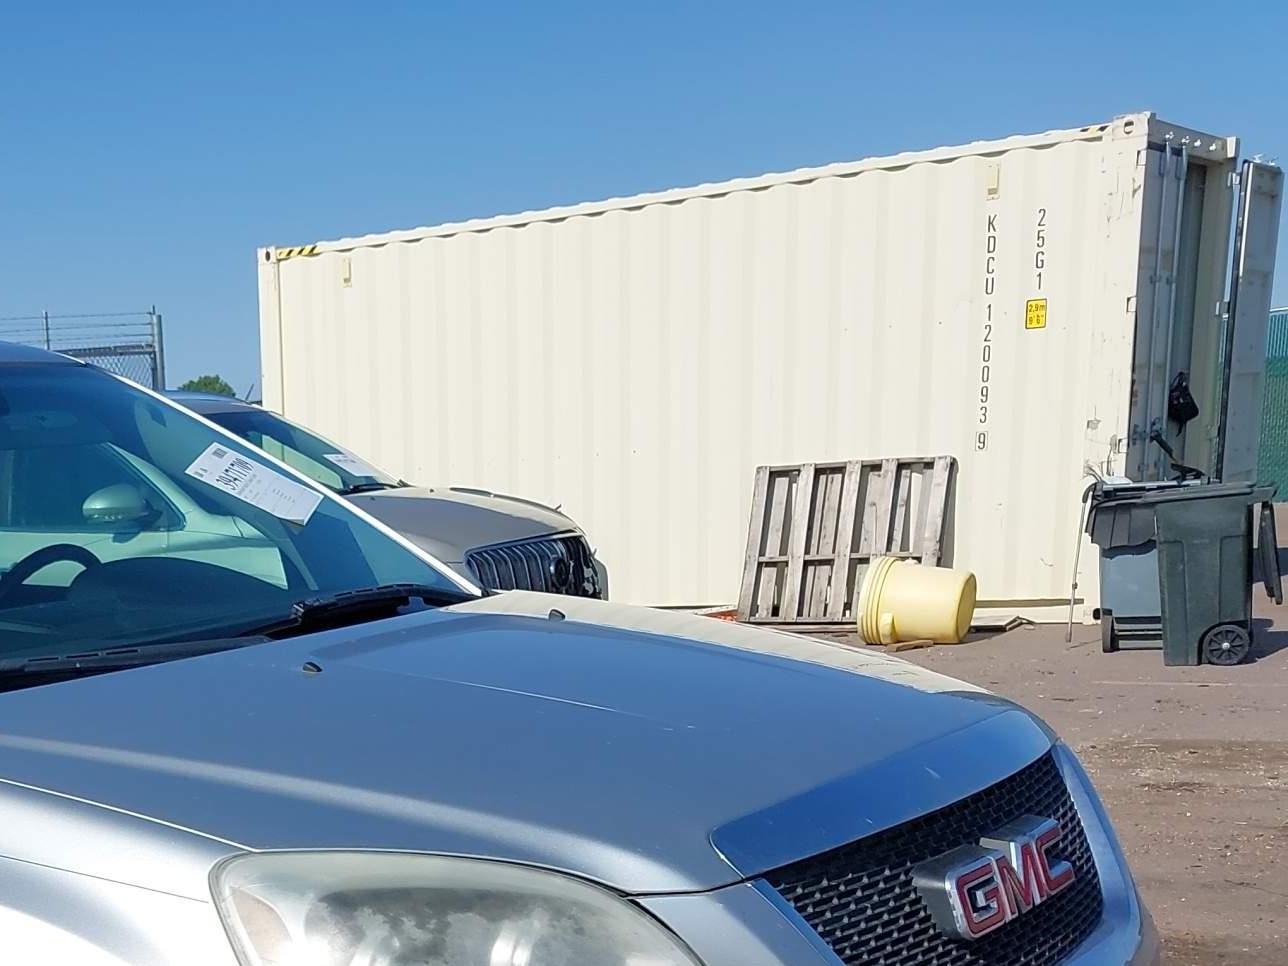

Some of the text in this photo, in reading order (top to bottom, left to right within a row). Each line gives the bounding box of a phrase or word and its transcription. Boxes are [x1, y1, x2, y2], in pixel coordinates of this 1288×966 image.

[985, 214, 998, 296] KDCU
[1035, 208, 1047, 290] 25G1
[979, 303, 993, 424] 120093
[945, 818, 1075, 940] GMC
